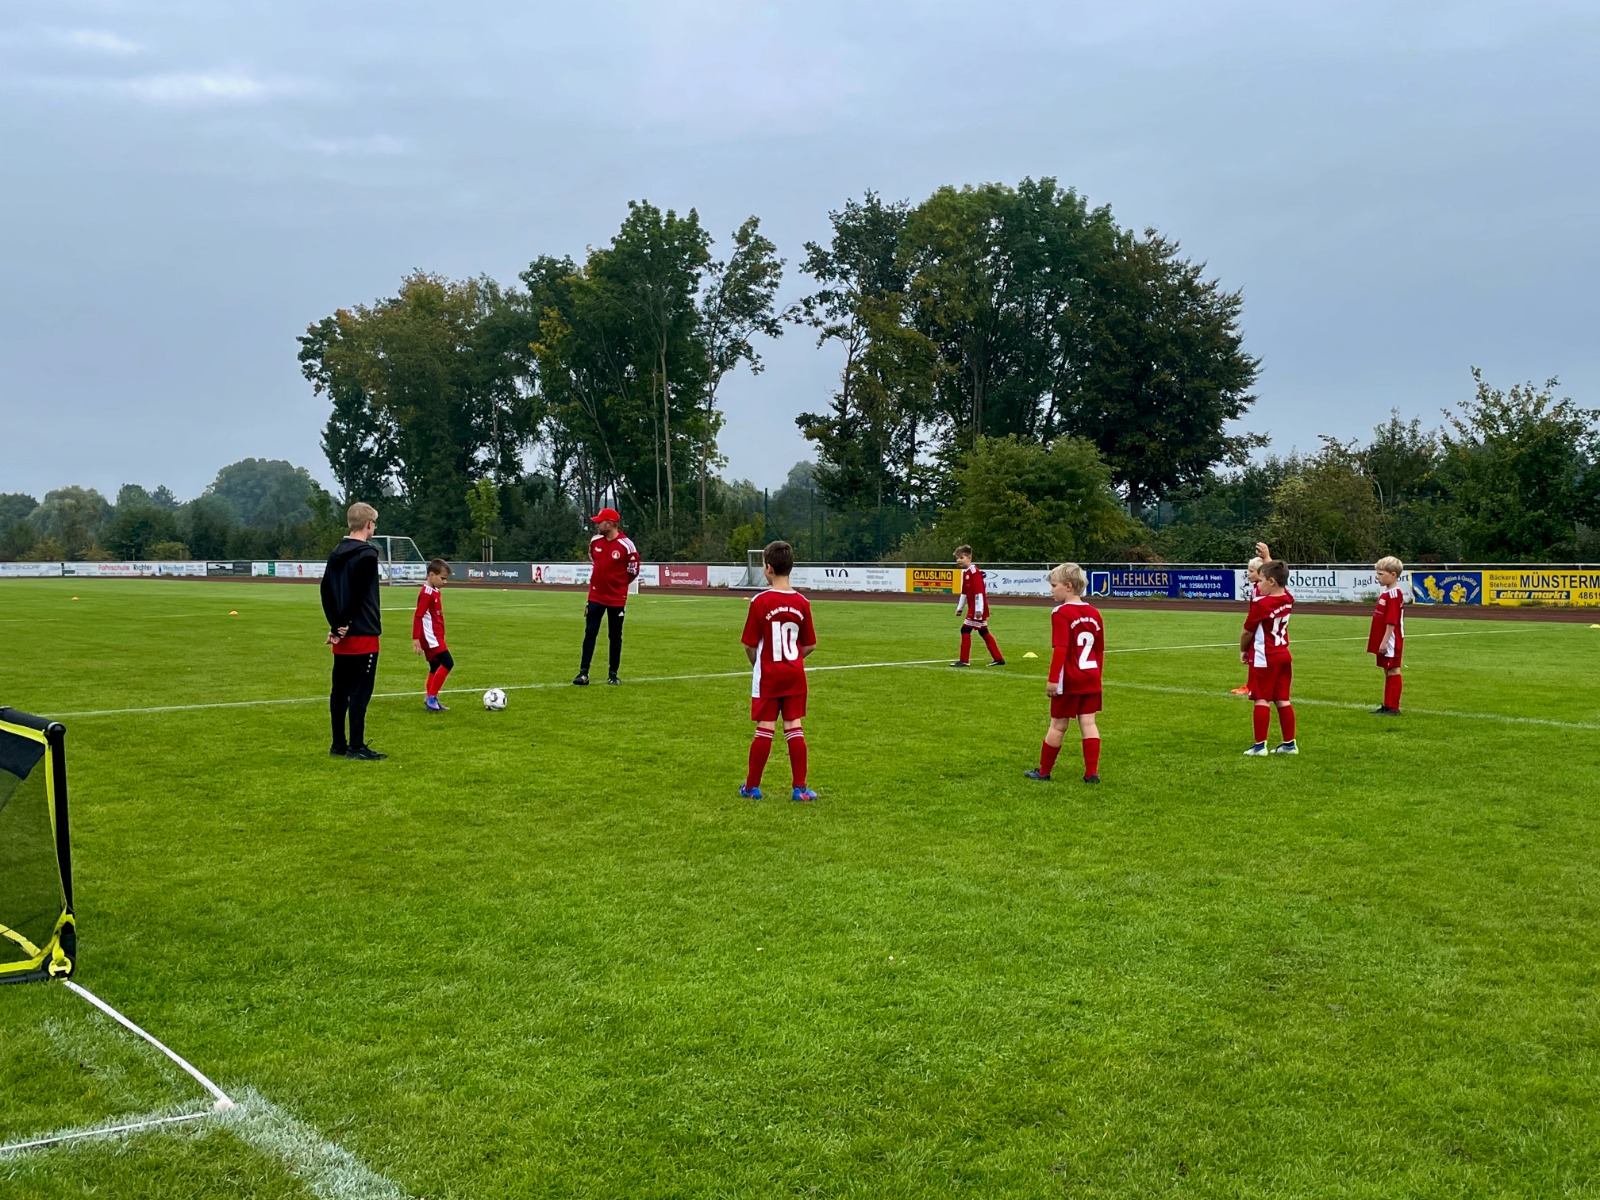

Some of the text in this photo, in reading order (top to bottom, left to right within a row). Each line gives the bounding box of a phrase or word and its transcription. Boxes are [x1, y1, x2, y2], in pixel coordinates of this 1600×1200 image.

[468, 569, 484, 577] Fliese
[914, 571, 952, 580] GAUSLING
[1112, 573, 1169, 585] H.FEHLKER
[1353, 575, 1373, 588] Jagd
[1499, 590, 1530, 600] aktiv
[1530, 590, 1567, 600] markt
[771, 621, 800, 662] 10
[1077, 631, 1098, 670] 2
